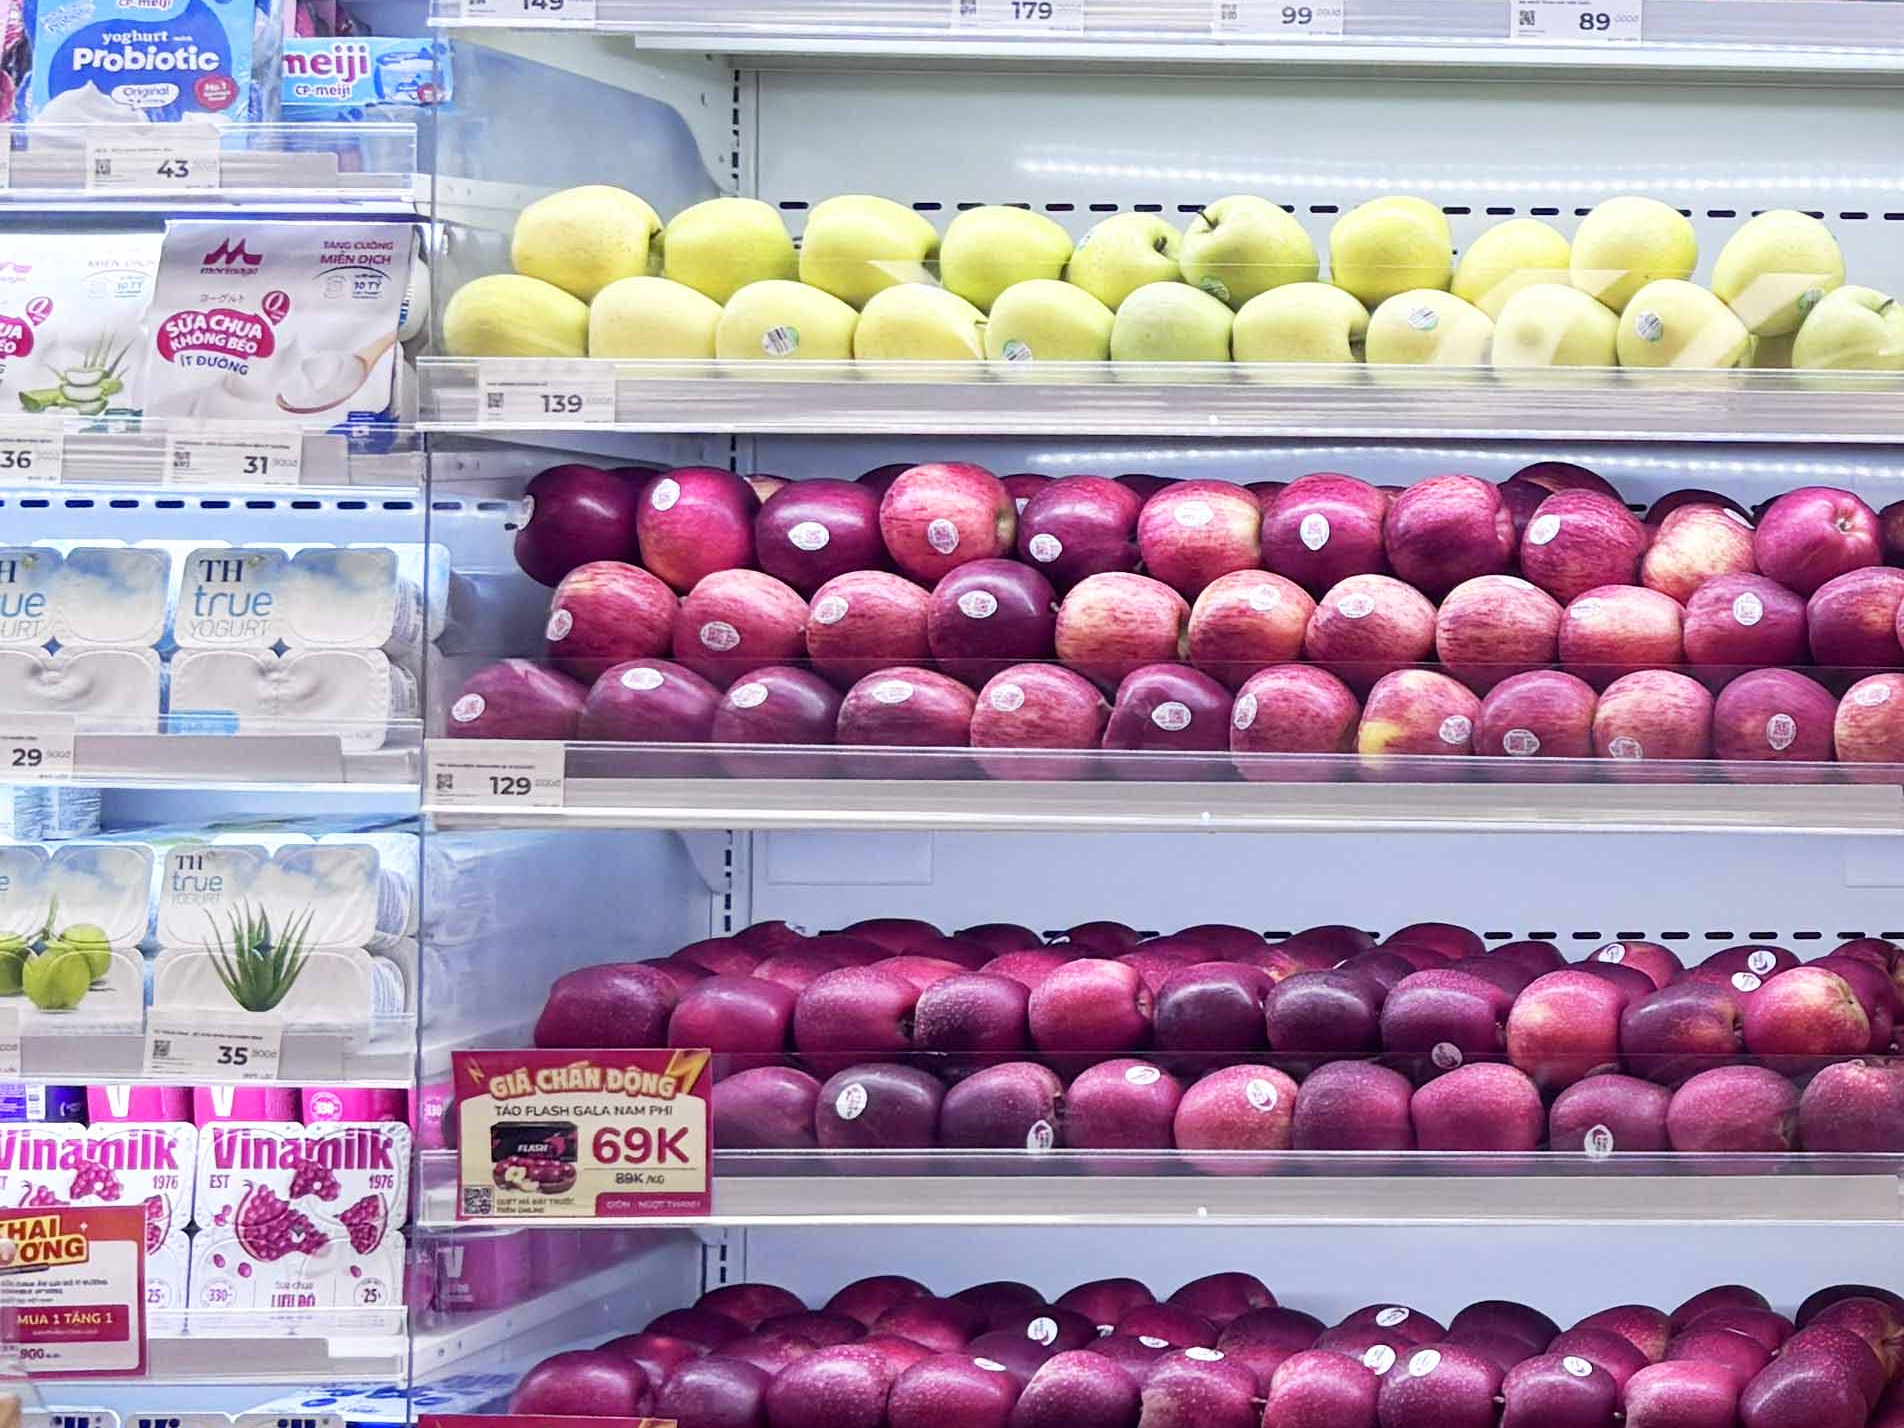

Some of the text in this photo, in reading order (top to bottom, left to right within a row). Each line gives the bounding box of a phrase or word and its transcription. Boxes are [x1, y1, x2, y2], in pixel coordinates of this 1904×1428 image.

[1011, 2, 1053, 19] 179
[1282, 7, 1312, 24] 99
[1579, 13, 1611, 30] 89
[102, 32, 168, 46] yoghurt
[73, 44, 221, 72] Probiotic
[283, 45, 369, 83] meiji
[157, 159, 189, 178] 43
[166, 312, 263, 340] SỮA CHUA
[170, 330, 258, 355] KHÔNG BÉO
[541, 395, 582, 413] 139
[0, 451, 31, 469] 36
[243, 456, 268, 474] 31
[199, 559, 244, 583] TH
[194, 584, 273, 617] true
[12, 748, 43, 767] 29
[489, 776, 531, 795] 129
[172, 872, 224, 893] true
[217, 1046, 248, 1065] 35
[489, 1060, 678, 1100] GIÁ CHẤN ĐỘNG
[494, 1104, 673, 1117] TÁO FLASH GALA NAM PHI
[213, 1128, 393, 1172] Vinamilk
[591, 1126, 689, 1166] 69K
[152, 1174, 180, 1191] 1976
[210, 1174, 394, 1190] EST 1976
